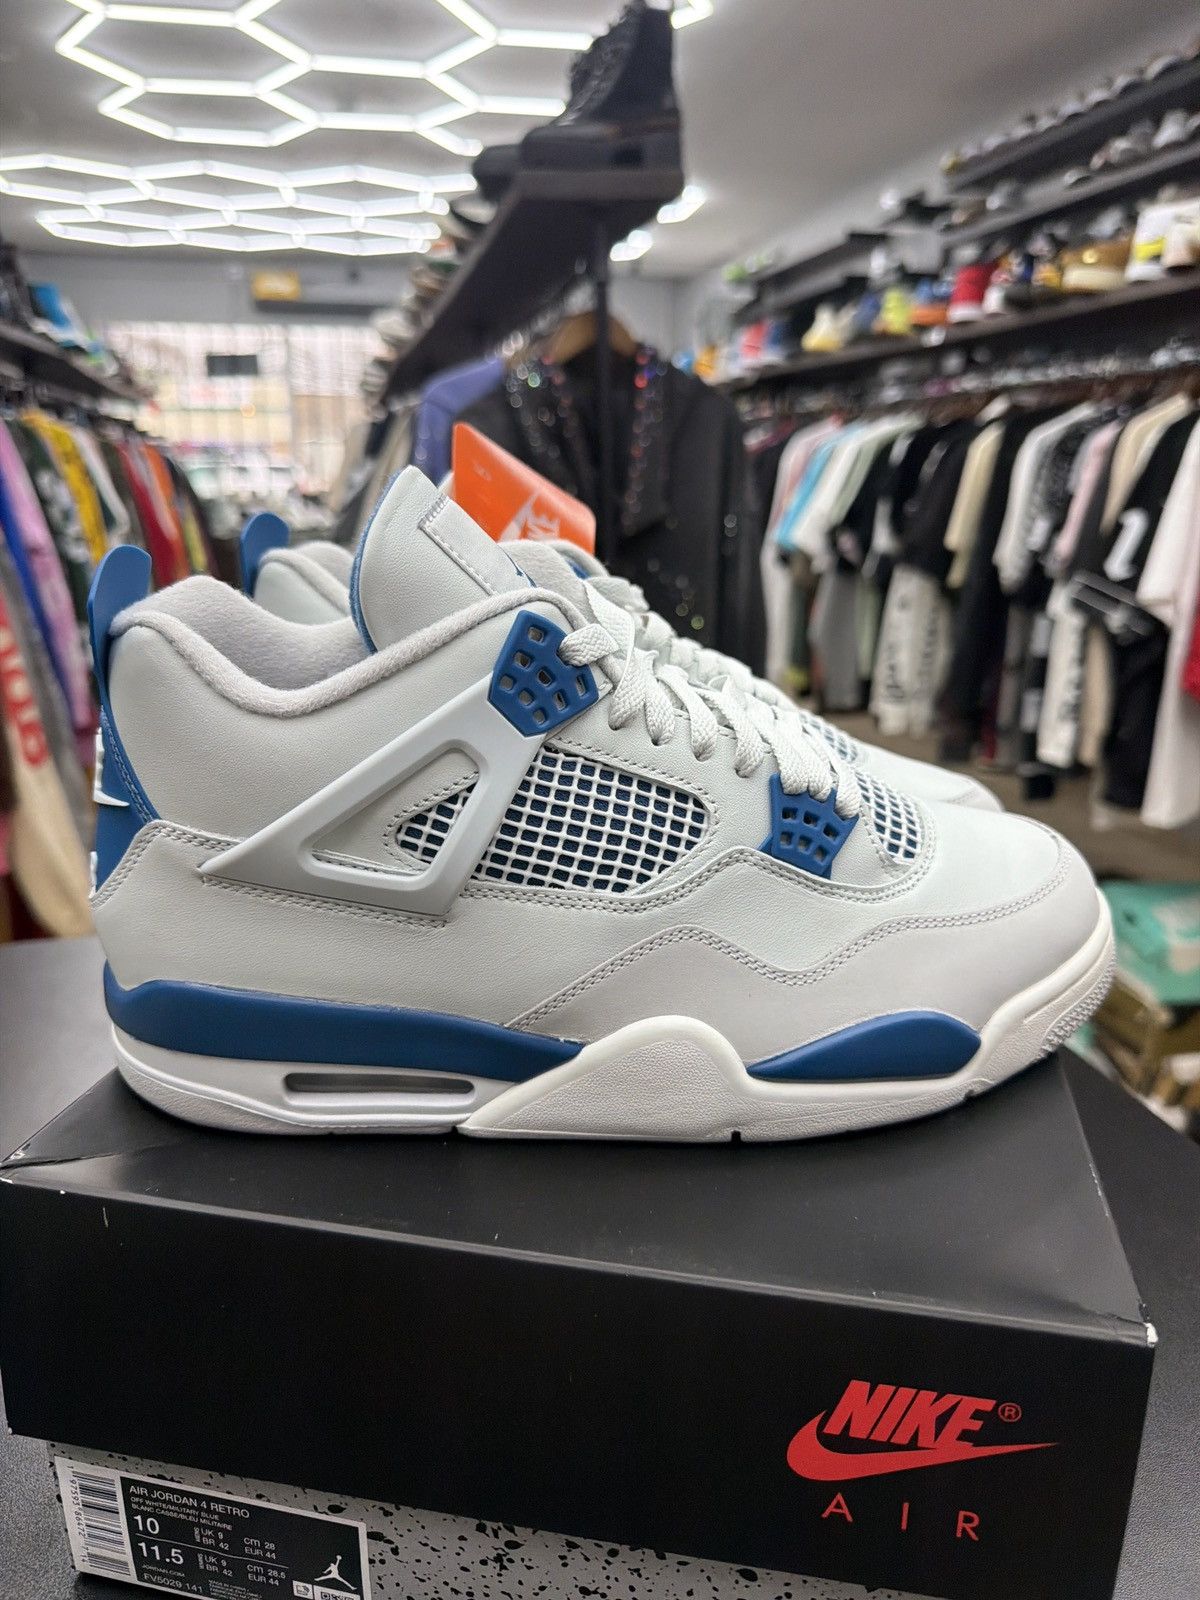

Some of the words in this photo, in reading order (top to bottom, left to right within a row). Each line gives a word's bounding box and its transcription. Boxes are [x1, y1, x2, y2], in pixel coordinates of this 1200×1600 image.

[822, 1379, 996, 1448] NIKE
[129, 1486, 148, 1496] AIR
[151, 1490, 198, 1507] JORDAN
[200, 1500, 207, 1508] 4
[210, 1503, 250, 1518] RETRO
[132, 1504, 154, 1513] BLANC
[200, 1512, 220, 1520] BLUE
[821, 1492, 981, 1541] AIR
[134, 1515, 160, 1535] 10
[201, 1528, 214, 1537] UK
[218, 1532, 224, 1540] 9
[202, 1538, 216, 1546] BR
[218, 1542, 230, 1550] 42
[244, 1538, 260, 1547] cm
[264, 1542, 276, 1550] 28
[138, 1542, 184, 1565] 11.5
[204, 1554, 218, 1564] UK
[244, 1546, 264, 1556] EUR
[265, 1552, 276, 1560] 44
[206, 1564, 219, 1573] BR
[222, 1568, 233, 1577] 42
[247, 1564, 264, 1573] cm
[268, 1569, 286, 1579] 28.5
[144, 1572, 182, 1588] FV5029
[185, 1583, 203, 1593] 141
[248, 1573, 266, 1583] EUR
[268, 1578, 279, 1586] 44
